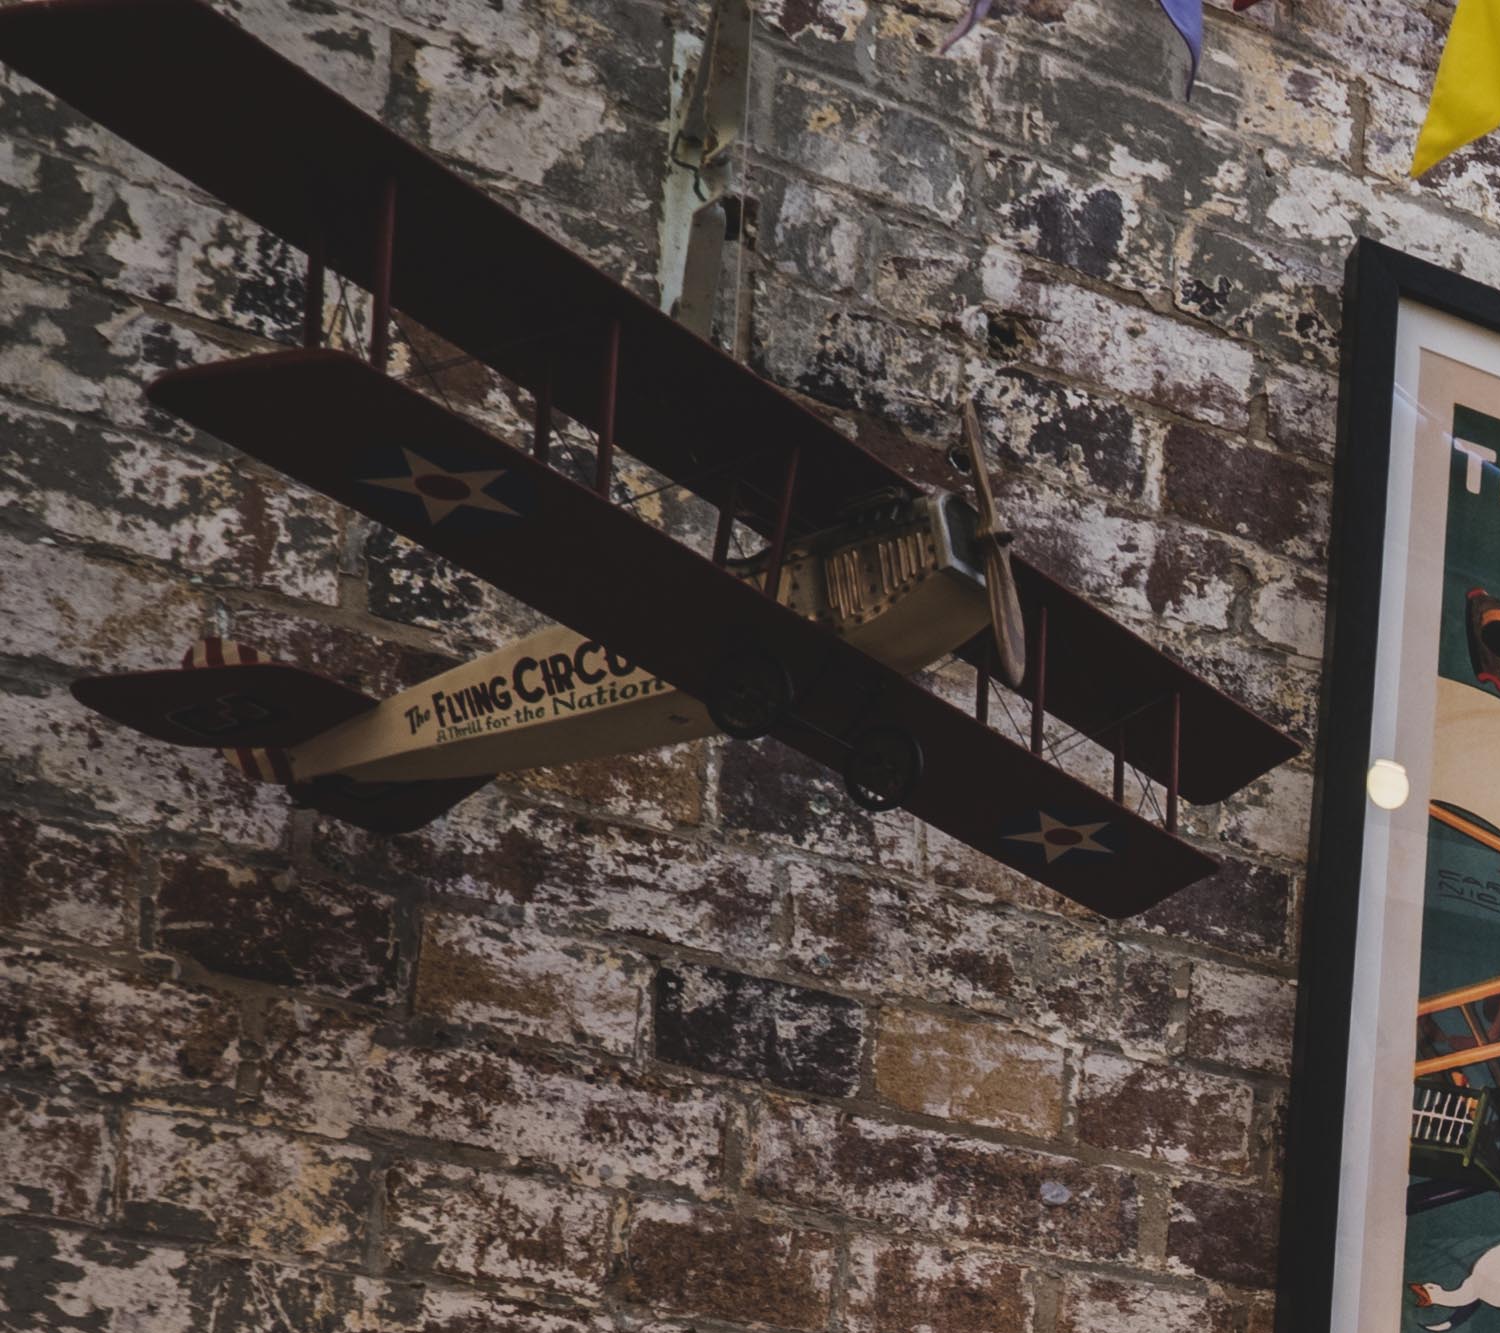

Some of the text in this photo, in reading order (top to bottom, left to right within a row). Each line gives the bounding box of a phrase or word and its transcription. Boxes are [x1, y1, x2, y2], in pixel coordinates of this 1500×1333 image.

[404, 640, 637, 735] The FLYING CIRCU
[448, 720, 483, 740] Thrill
[485, 714, 512, 736] for
[514, 704, 546, 723] the
[552, 677, 666, 715] Nation
